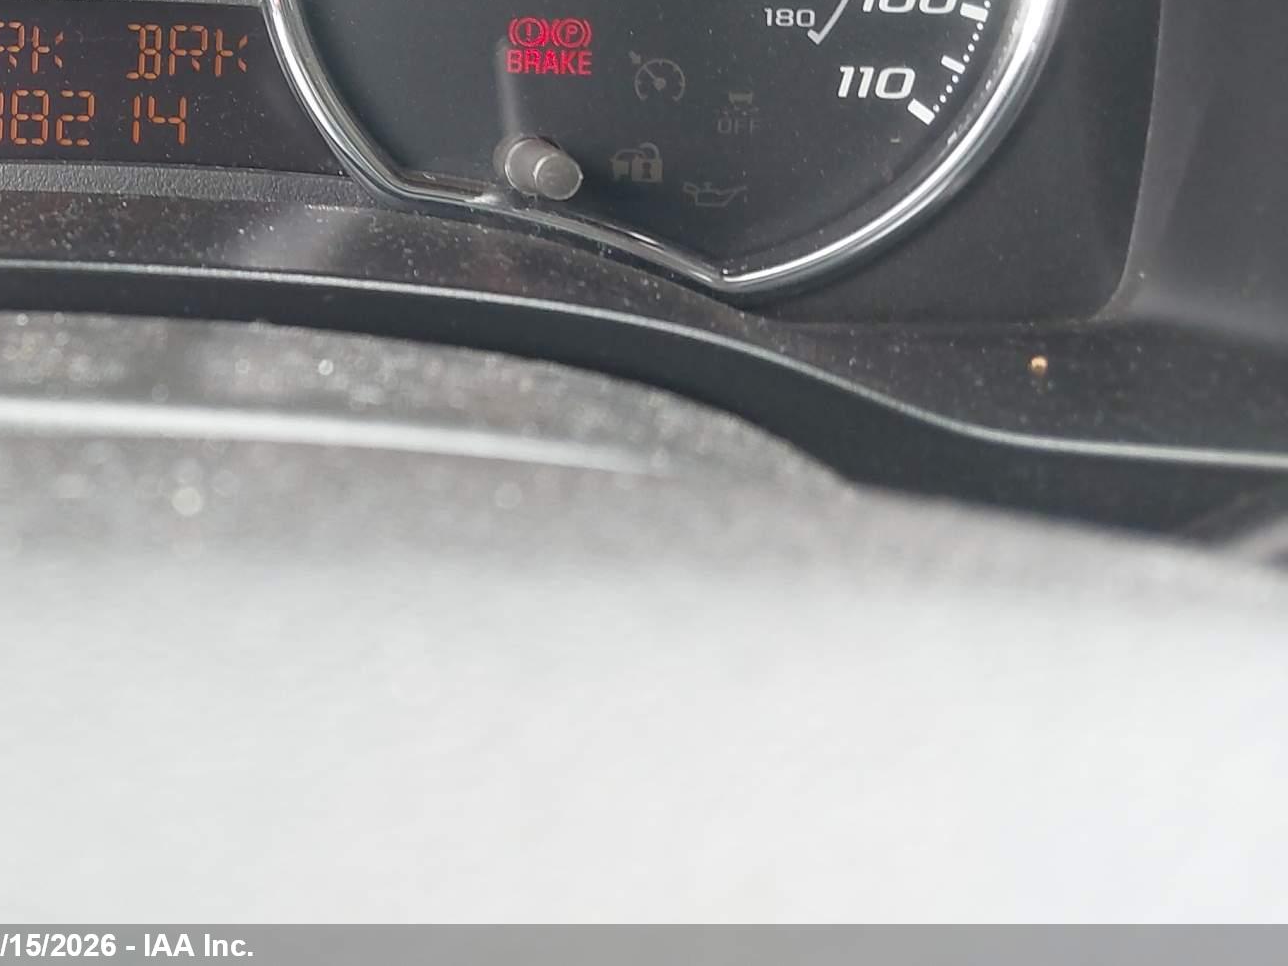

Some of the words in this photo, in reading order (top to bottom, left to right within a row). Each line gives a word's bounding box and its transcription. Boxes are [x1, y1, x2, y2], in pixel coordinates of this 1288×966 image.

[764, 8, 816, 28] 180
[126, 23, 249, 81] BRK
[505, 49, 593, 75] BRAKE
[837, 66, 916, 100] 110
